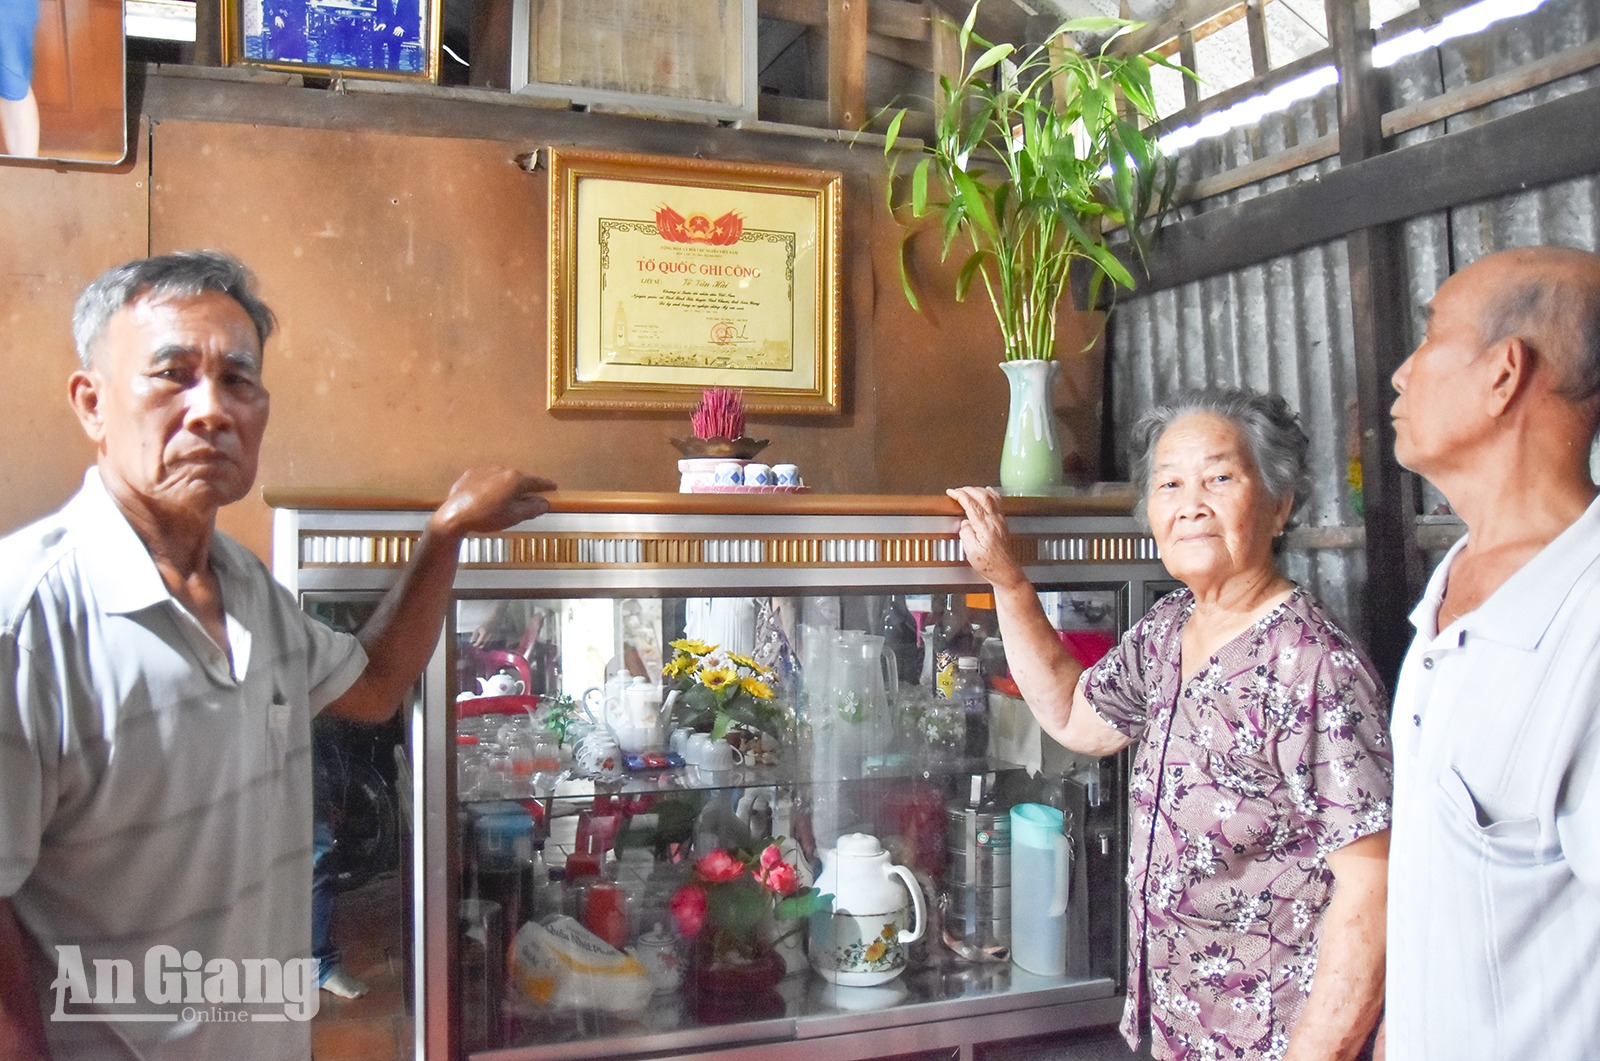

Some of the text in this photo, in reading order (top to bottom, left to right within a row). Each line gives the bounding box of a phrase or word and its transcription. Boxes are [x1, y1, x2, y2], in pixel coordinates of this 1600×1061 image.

[636, 257, 762, 278] TỔ QUỐC GHI CÔNG
